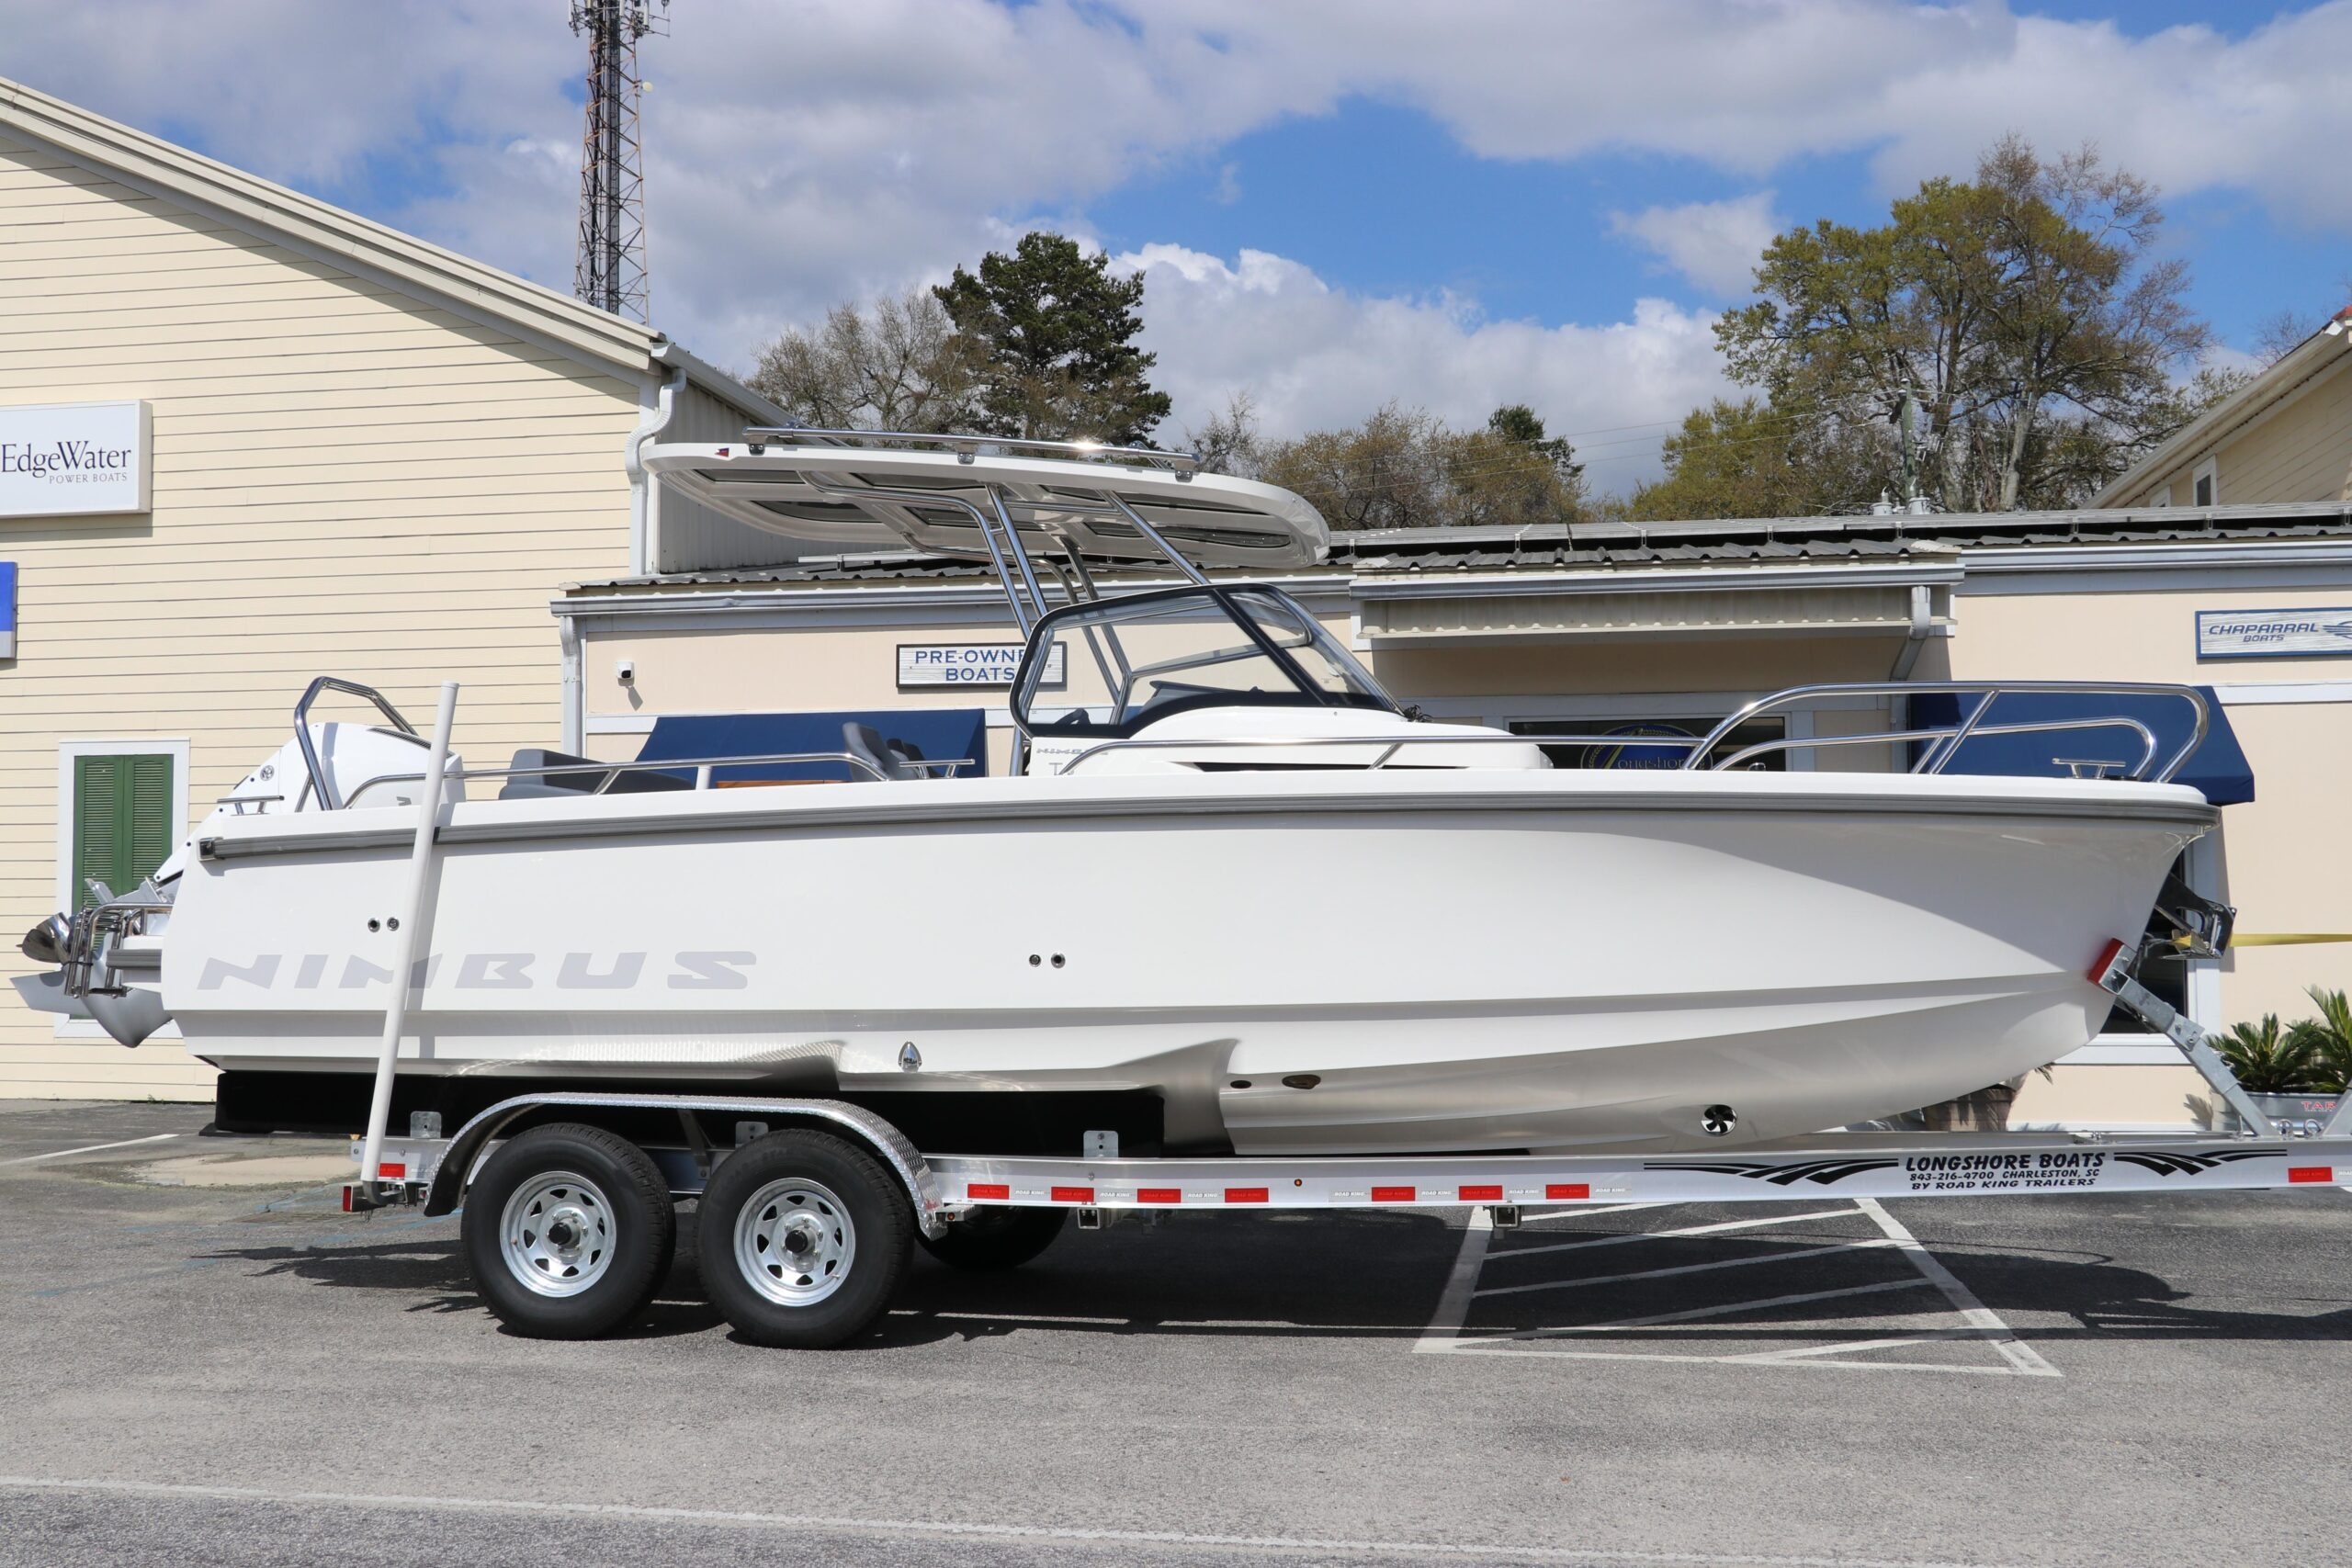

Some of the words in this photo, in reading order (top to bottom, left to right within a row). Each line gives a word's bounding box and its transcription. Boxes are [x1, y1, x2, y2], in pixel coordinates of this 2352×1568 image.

[1, 440, 131, 478] EdgeWater
[49, 473, 89, 484] POWER
[92, 472, 128, 482] BOATS
[2209, 623, 2319, 635] CHAPARRAL
[2243, 634, 2285, 643] BOATS
[915, 649, 1026, 664] PRE-OWN
[945, 667, 1015, 682] BOATS
[196, 950, 758, 990] NIMBUS
[1905, 1154, 2032, 1172] LONGSHORE
[2039, 1152, 2106, 1169] BOATS
[1910, 1171, 1995, 1181] 843-216-4700
[2002, 1169, 2081, 1179] CHARLESTON,
[2086, 1168, 2100, 1177] SC
[1912, 1182, 1930, 1190] BY
[1936, 1181, 1976, 1190] ROAD
[1982, 1179, 2019, 1189] KING
[2025, 1178, 2097, 1188] TRAILERS
